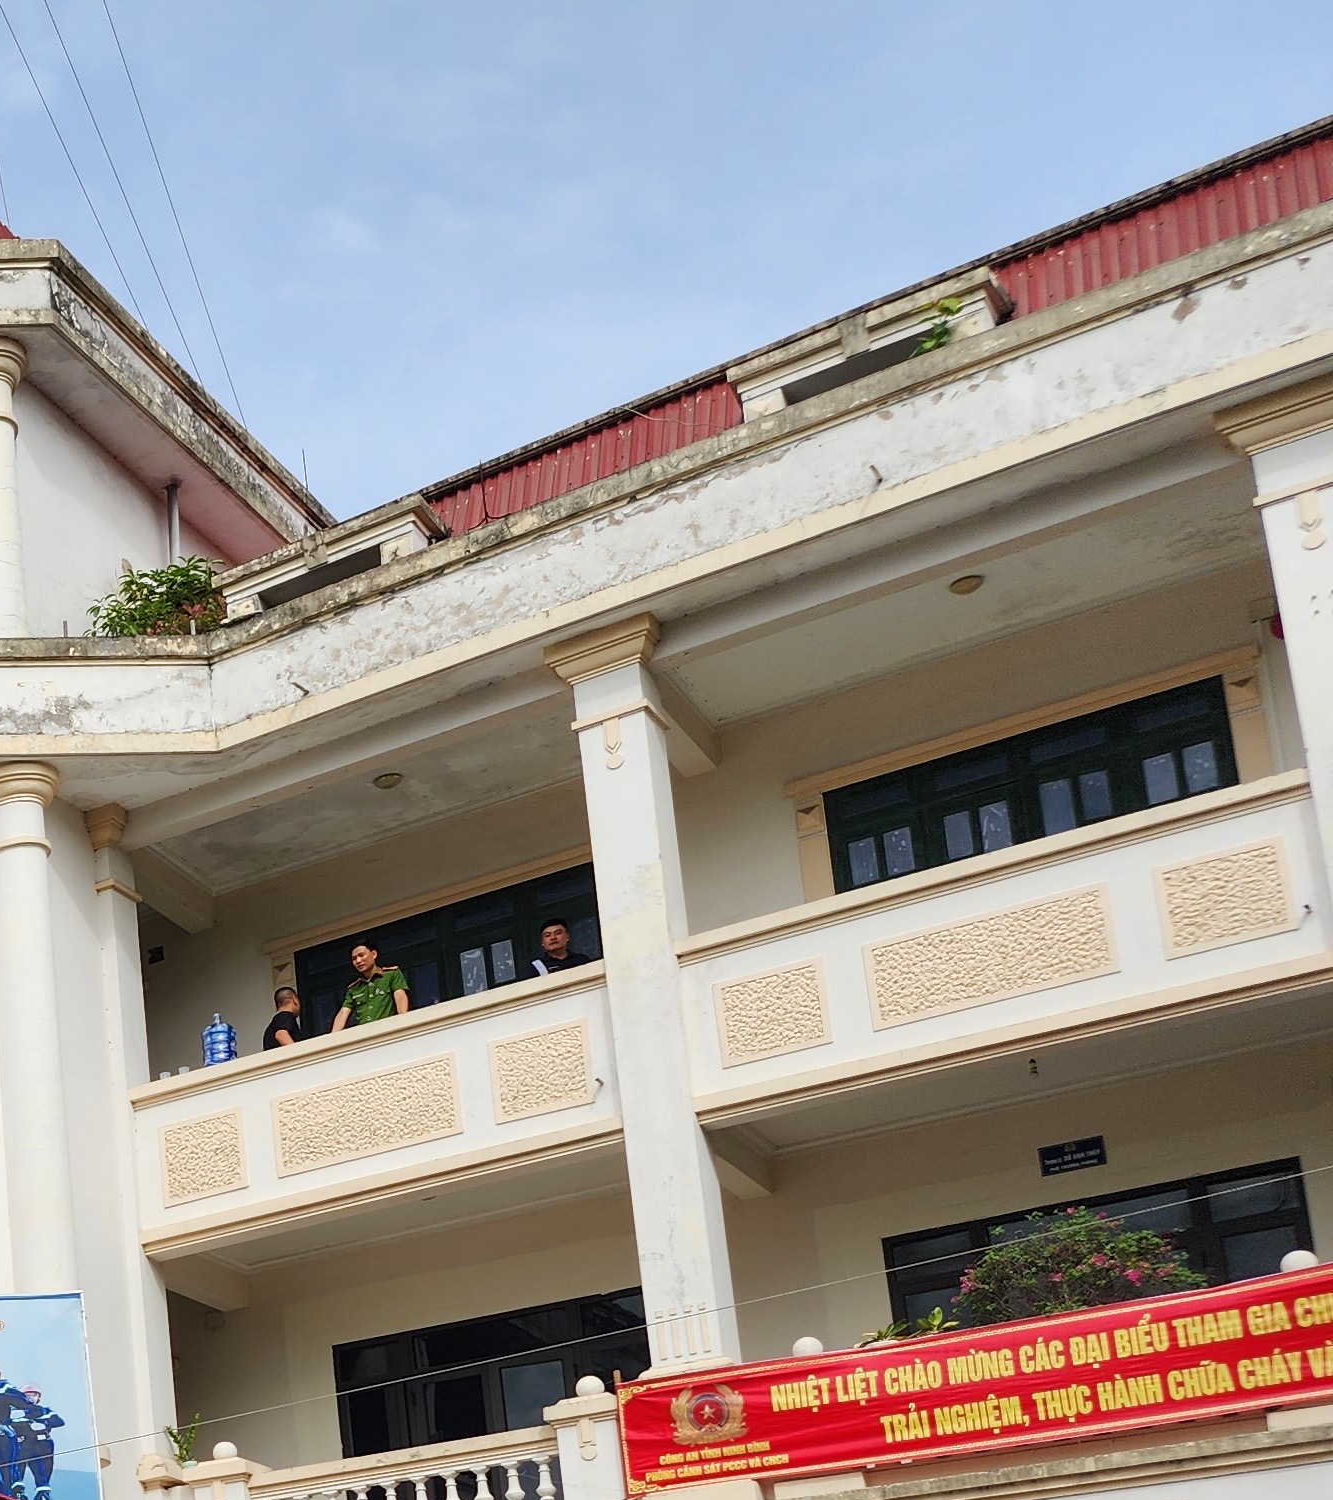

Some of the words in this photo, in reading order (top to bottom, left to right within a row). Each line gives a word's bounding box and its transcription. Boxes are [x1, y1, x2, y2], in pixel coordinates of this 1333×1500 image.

[770, 1375, 830, 1412] NHIỆT
[836, 1367, 879, 1406] LIỆT
[884, 1358, 942, 1395] CHÀO
[946, 1348, 1015, 1385] MỪNG
[1018, 1337, 1065, 1374] CÁC
[1069, 1331, 1110, 1368] ĐẠI
[1113, 1313, 1170, 1359] BIỂU
[1172, 1309, 1243, 1348] THAM
[1246, 1301, 1292, 1336] GIA
[880, 1402, 931, 1444] TRẢI
[933, 1393, 1030, 1436] NGHIỆM,
[1032, 1383, 1093, 1423] THỰC
[1097, 1374, 1164, 1411] HÀNH
[1167, 1360, 1235, 1400] CHỮA
[1237, 1348, 1302, 1389] CHÁY
[686, 1451, 699, 1462] AN
[703, 1461, 721, 1474] SÁT
[722, 1459, 747, 1472] PCCC
[749, 1456, 762, 1468] VÀ
